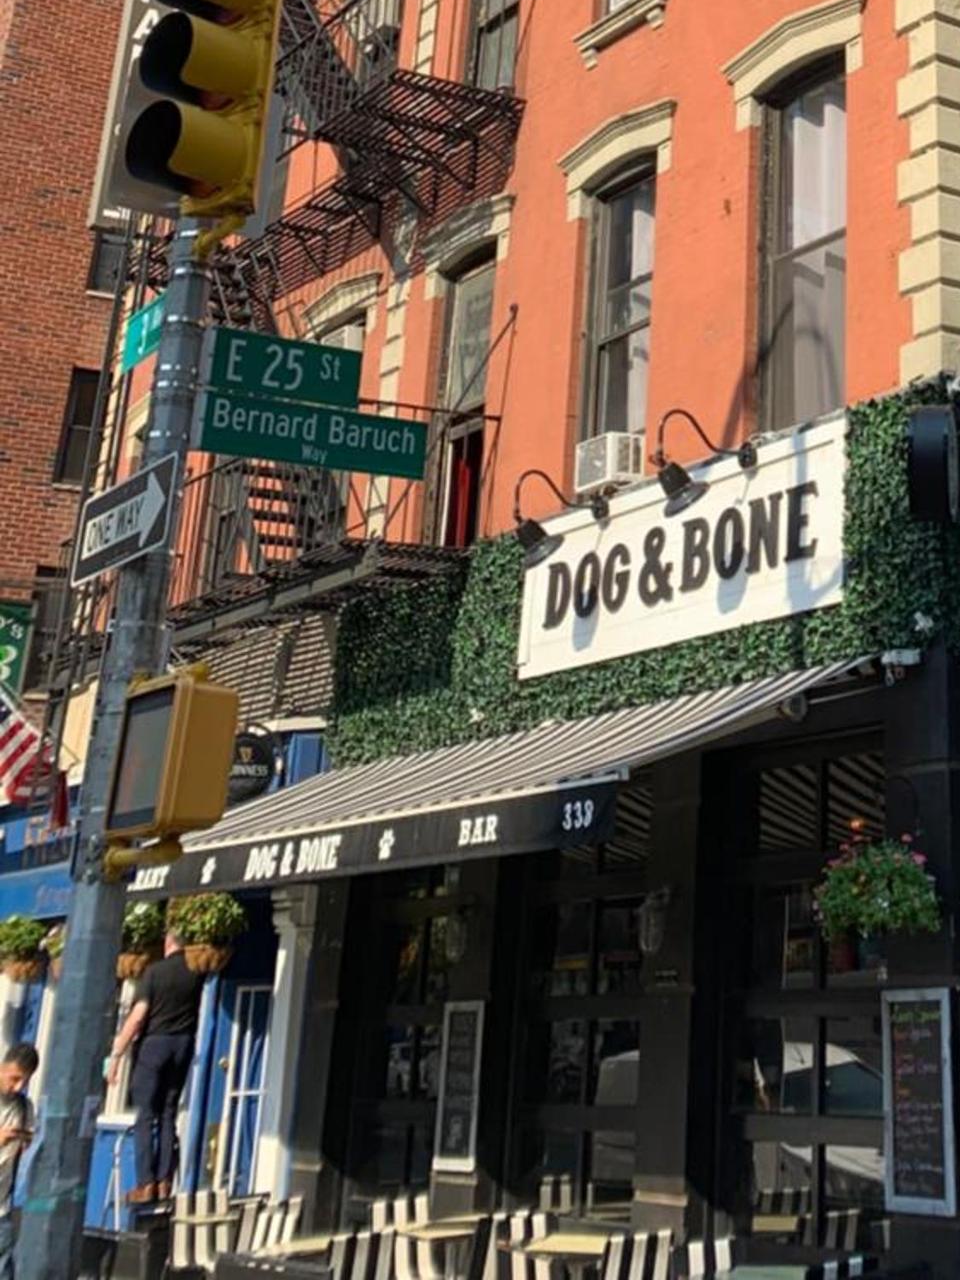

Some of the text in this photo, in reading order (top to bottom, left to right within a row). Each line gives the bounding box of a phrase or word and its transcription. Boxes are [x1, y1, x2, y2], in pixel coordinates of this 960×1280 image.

[226, 338, 341, 391] E 25 St
[212, 398, 416, 455] Bernard Baruch
[301, 444, 328, 465] Way
[87, 494, 145, 552] ONE WAY
[542, 543, 631, 630] DOG
[679, 481, 819, 594] BONE
[458, 814, 498, 847] BAR
[562, 799, 594, 831] 338
[243, 833, 342, 882] DOG & BONE
